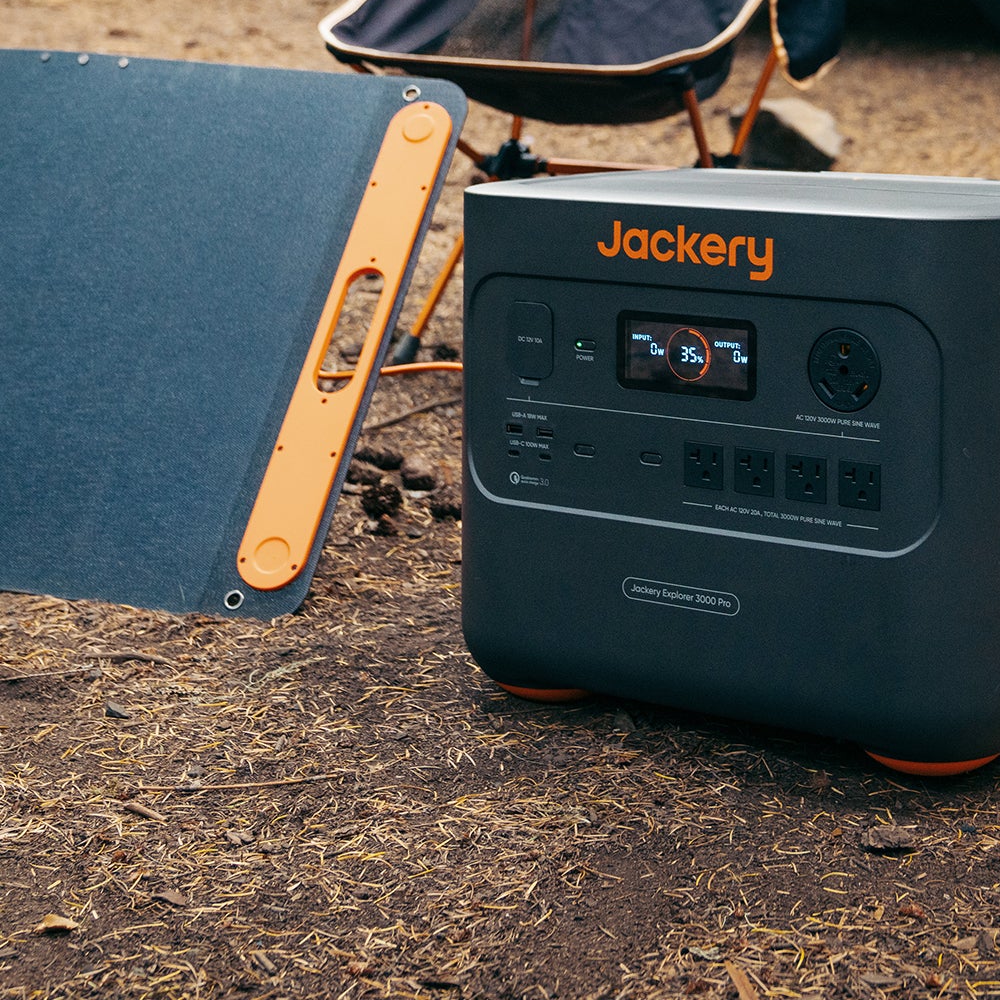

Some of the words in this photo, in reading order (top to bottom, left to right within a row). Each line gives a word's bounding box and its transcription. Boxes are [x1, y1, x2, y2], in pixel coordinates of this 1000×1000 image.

[596, 219, 774, 282] Jackery
[517, 335, 526, 343] DC
[631, 333, 653, 342] INPUT:
[713, 340, 741, 350] OUTPUT:
[576, 354, 595, 362] POWER
[680, 345, 704, 364] 35%
[816, 416, 837, 425] 3000W
[837, 418, 851, 426] PURE
[851, 420, 864, 428] SINE
[864, 422, 881, 430] WAVE
[714, 503, 730, 512] EACH
[738, 507, 750, 515] 120V
[763, 510, 780, 519] TOTAL
[780, 512, 799, 521] 3000W
[799, 515, 814, 523] PURE
[814, 517, 826, 525] SINE
[826, 519, 843, 528] WAVE
[630, 583, 661, 598] Jackery
[662, 588, 694, 602] Explorer
[695, 593, 717, 606] 3000
[718, 597, 732, 609] Pro
